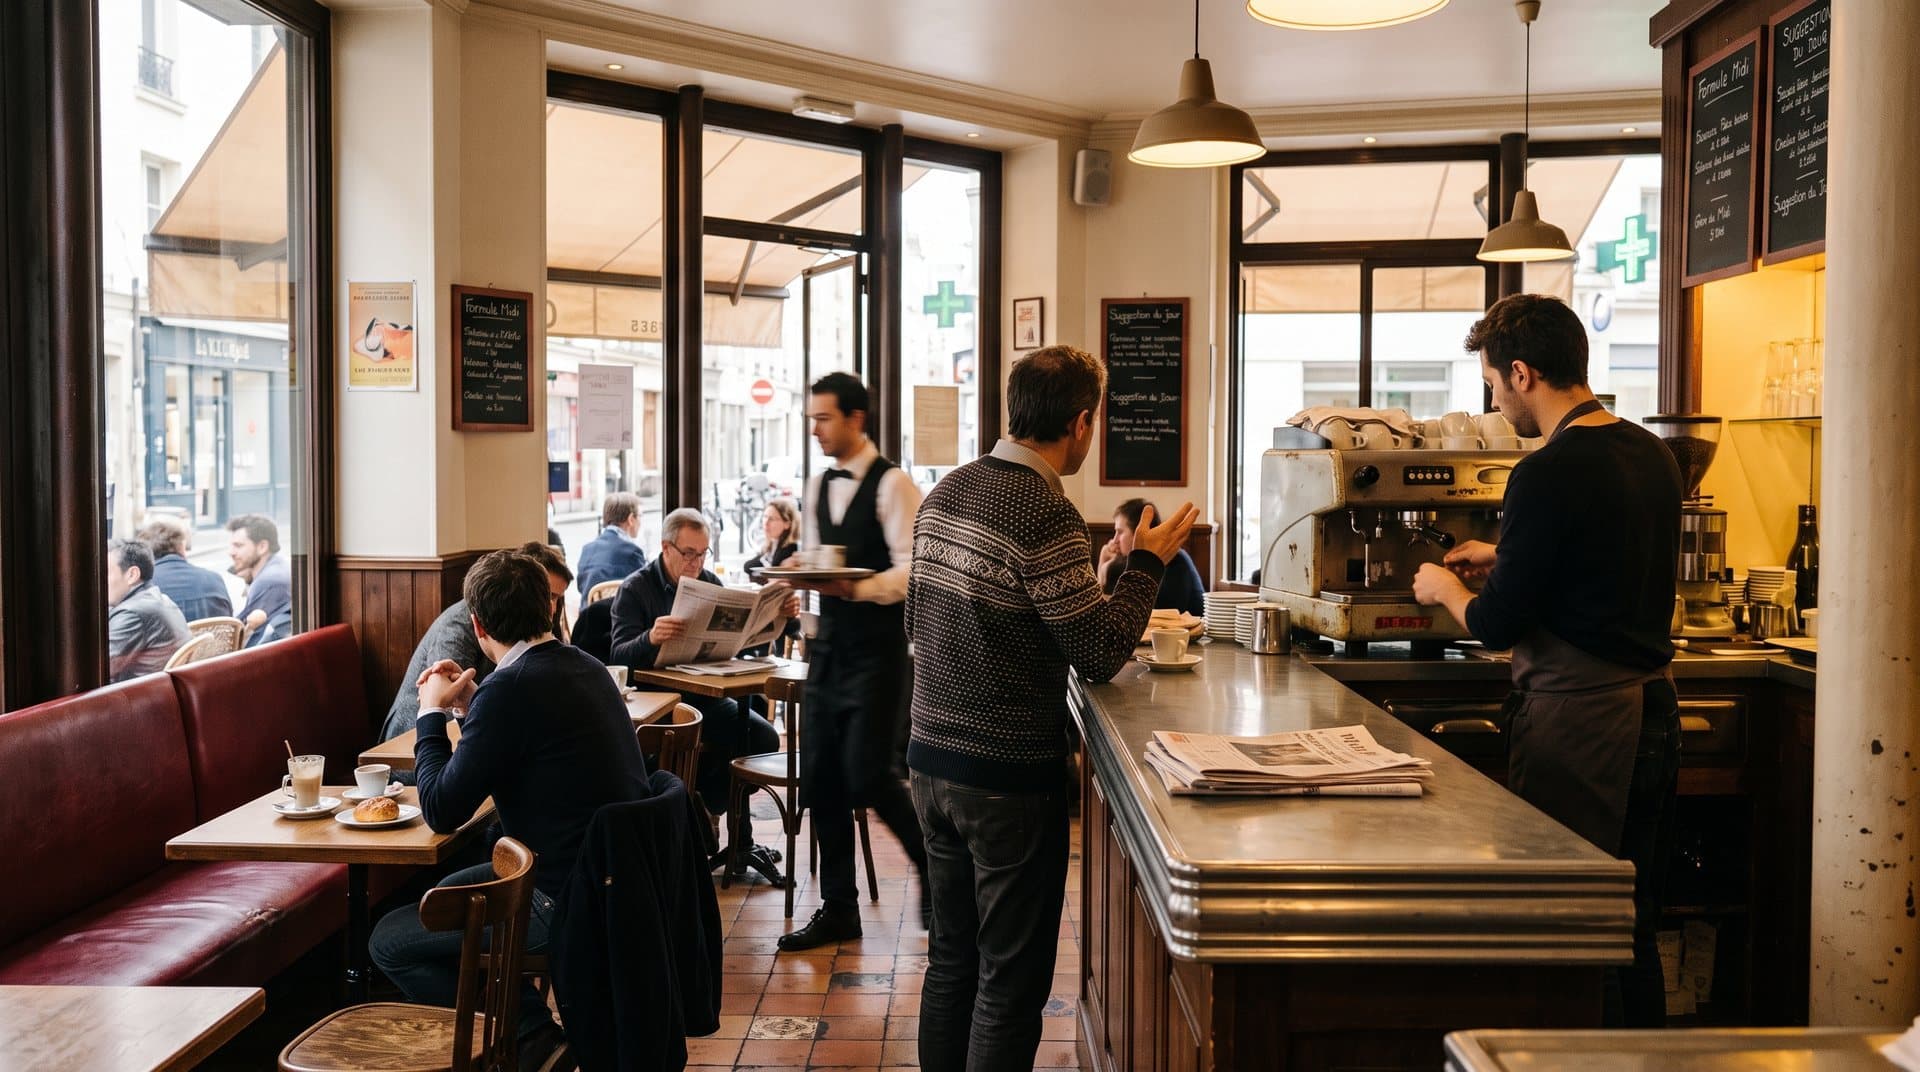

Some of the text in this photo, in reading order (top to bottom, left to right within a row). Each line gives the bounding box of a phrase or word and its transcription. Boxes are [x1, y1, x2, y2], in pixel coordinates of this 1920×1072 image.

[1698, 56, 1750, 100] Formule Midi
[465, 298, 520, 317] Formule Midi
[1109, 308, 1181, 325] Suggestion du jour
